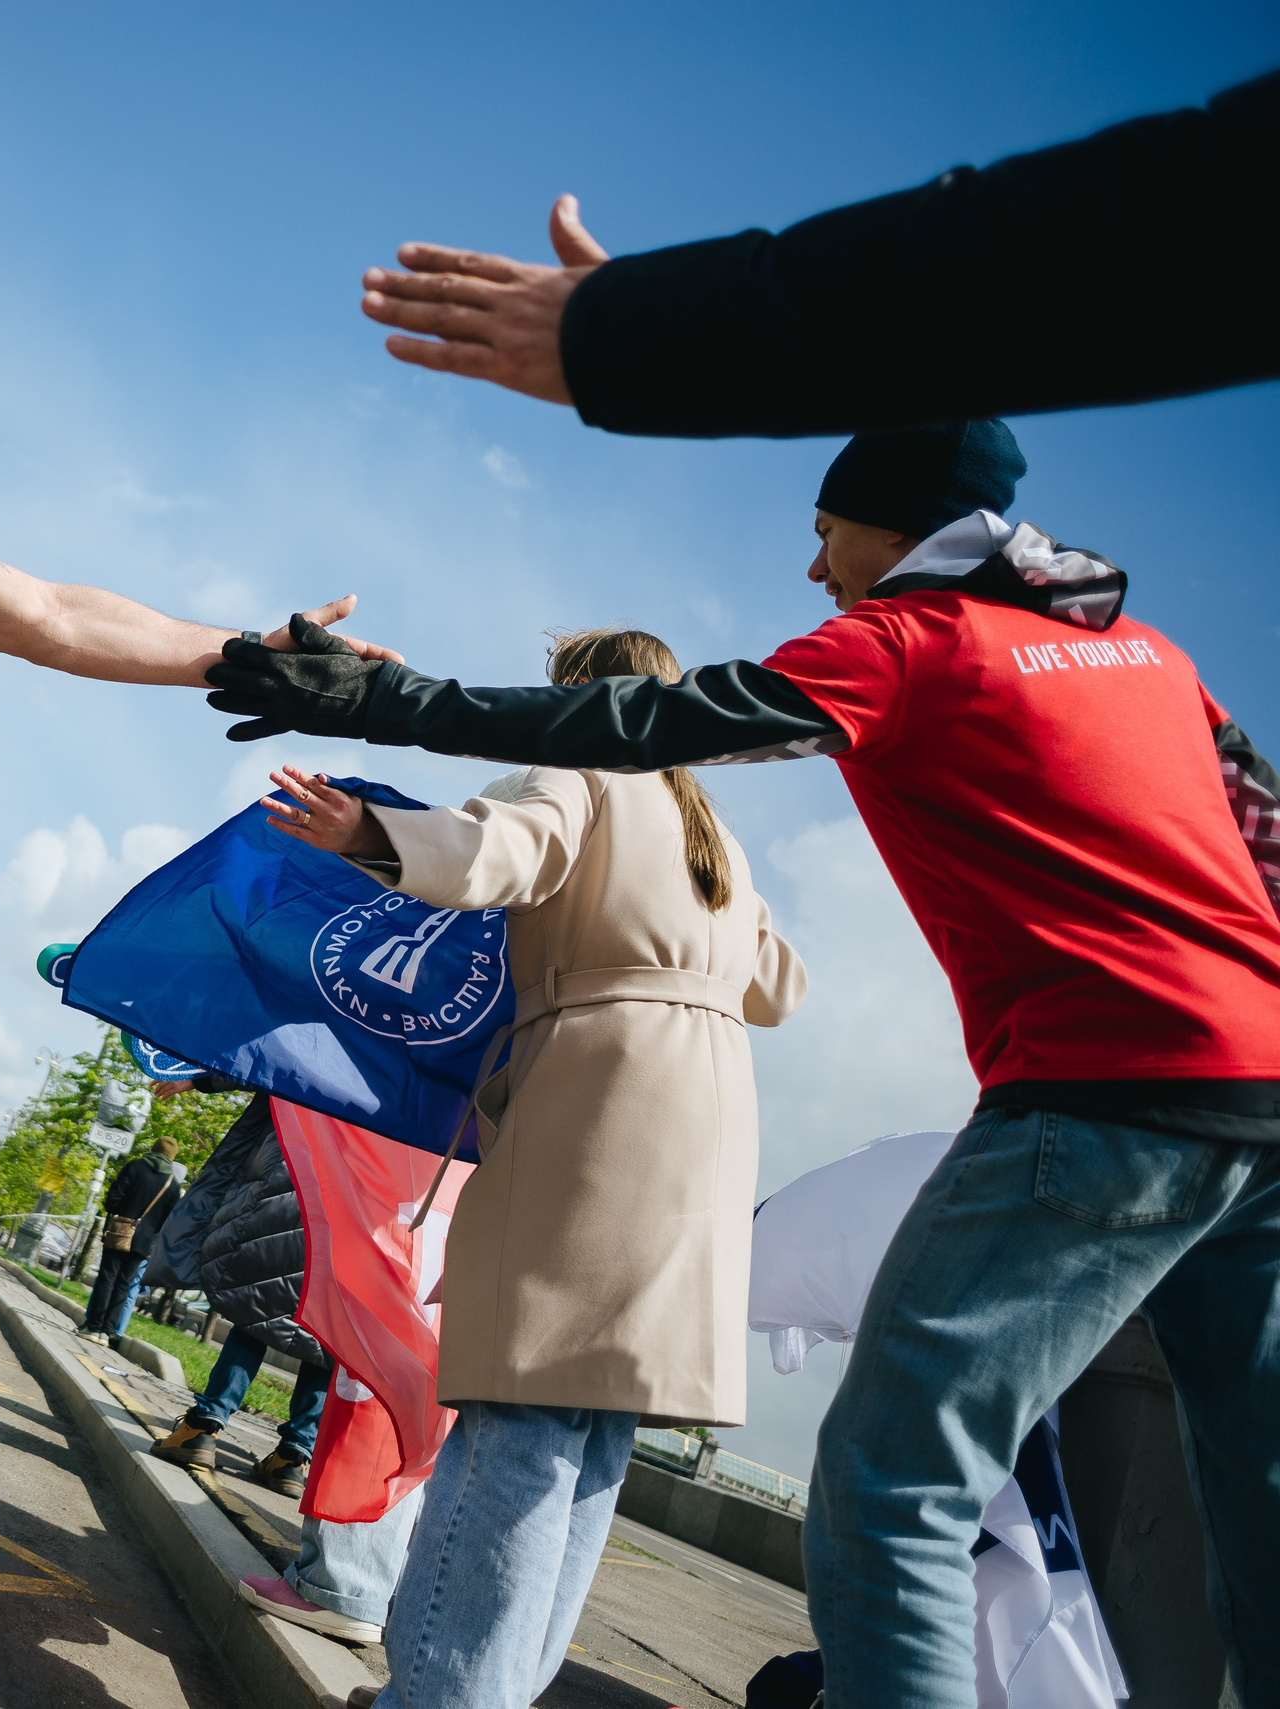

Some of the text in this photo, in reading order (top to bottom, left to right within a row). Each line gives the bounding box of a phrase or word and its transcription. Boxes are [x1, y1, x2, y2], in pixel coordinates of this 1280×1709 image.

[1011, 640, 1161, 674] LIVE YOUR LIFE
[105, 1132, 113, 1141] 15
[114, 1135, 127, 1146] 20
